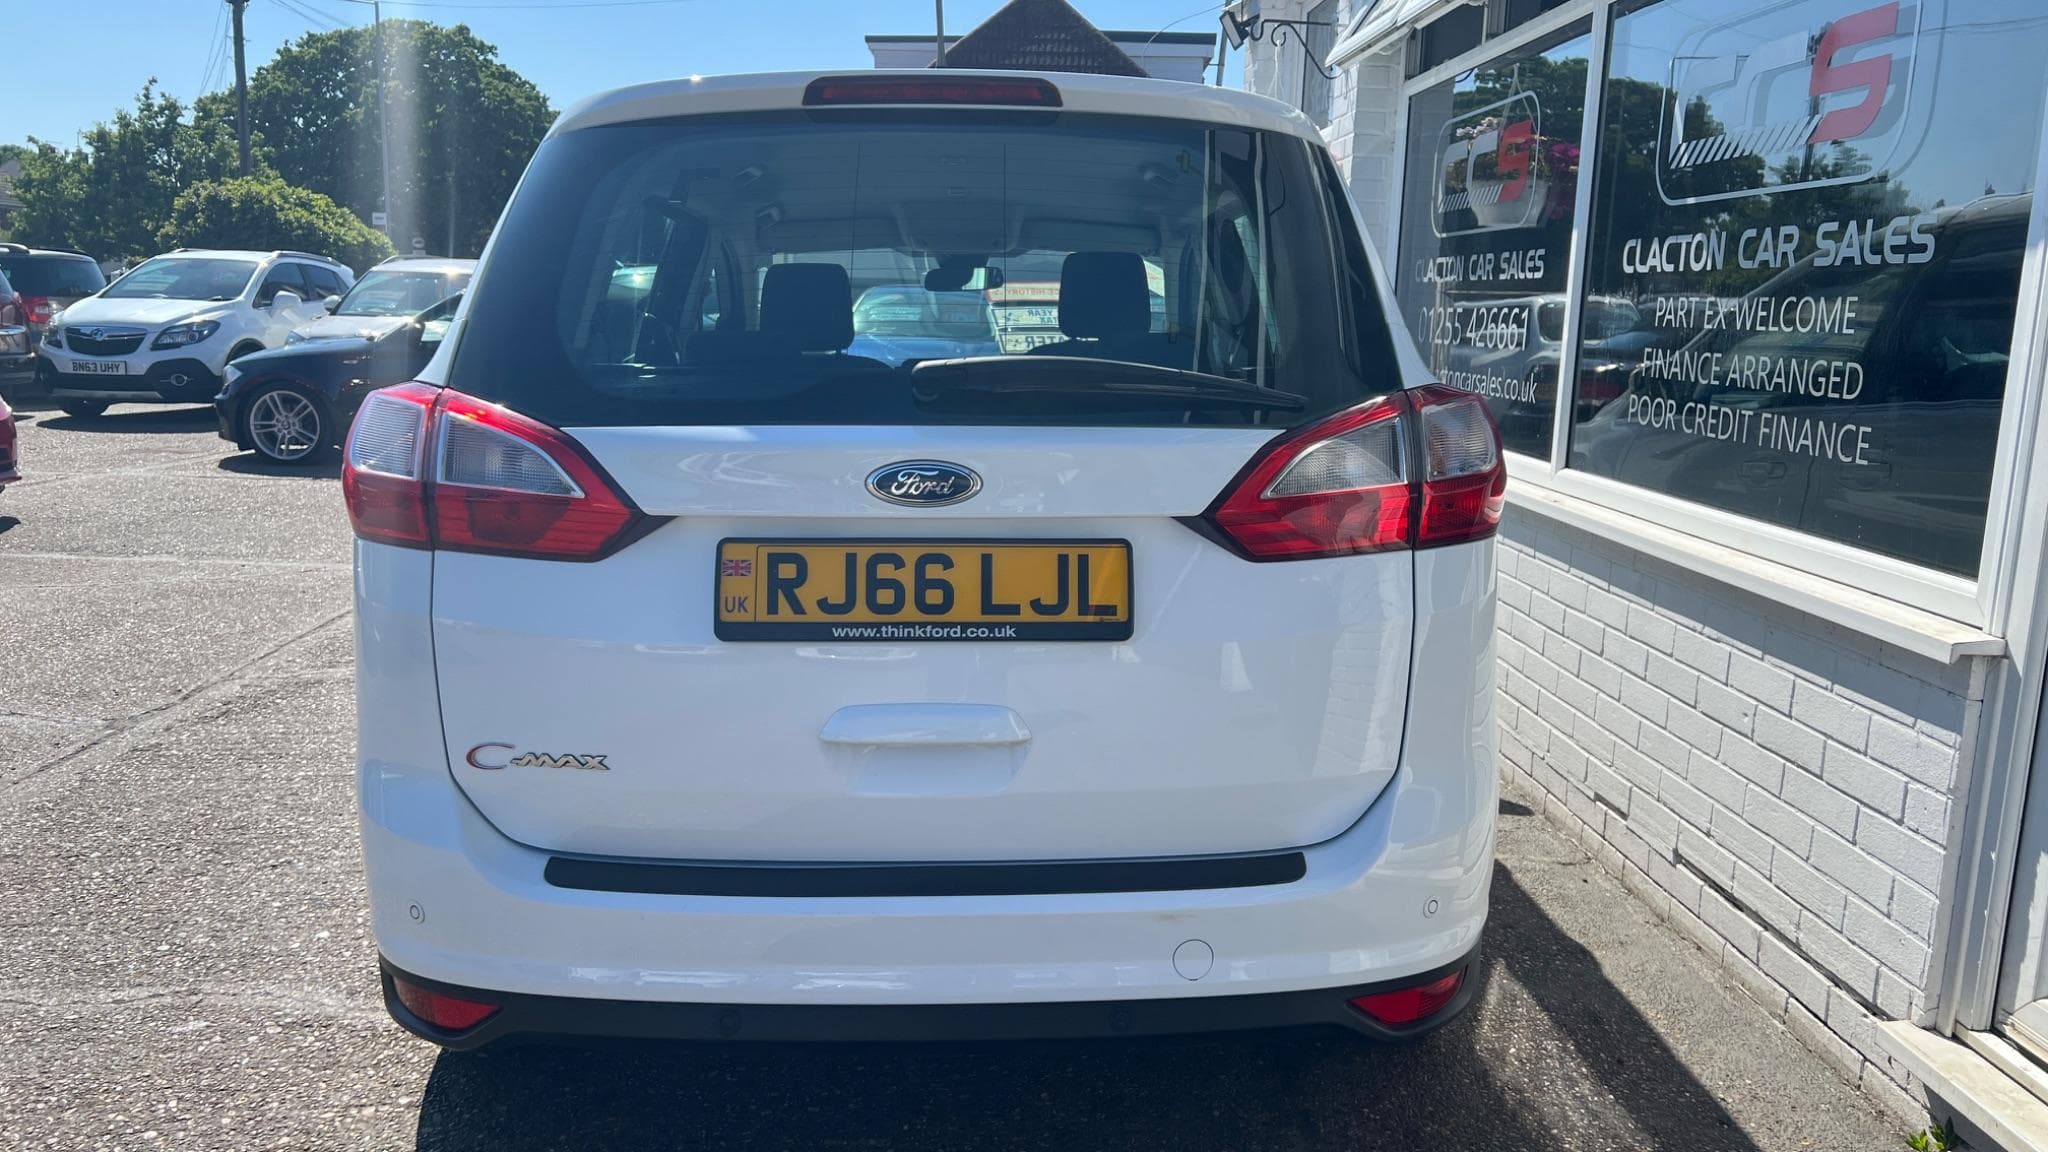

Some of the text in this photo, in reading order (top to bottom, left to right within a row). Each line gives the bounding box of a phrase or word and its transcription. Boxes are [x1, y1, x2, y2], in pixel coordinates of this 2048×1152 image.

[1622, 213, 1938, 274] CLACTON CAR SALES
[1416, 249, 1546, 283] CLACTON CAR SALES
[1418, 307, 1530, 351] 01255 426661
[1654, 296, 1858, 334] PART EX WELCOME
[72, 361, 121, 373] BN63 UHY
[1641, 348, 1864, 400] FINANCE ARRANGED
[1627, 394, 1872, 466] POOR CREDIT FINANCE
[891, 469, 955, 495] Ford
[767, 552, 1118, 616] RJ66 LJL
[724, 596, 749, 614] UK
[831, 625, 1017, 638] www.thinkford.co.uk
[466, 742, 611, 771] C-MAX
